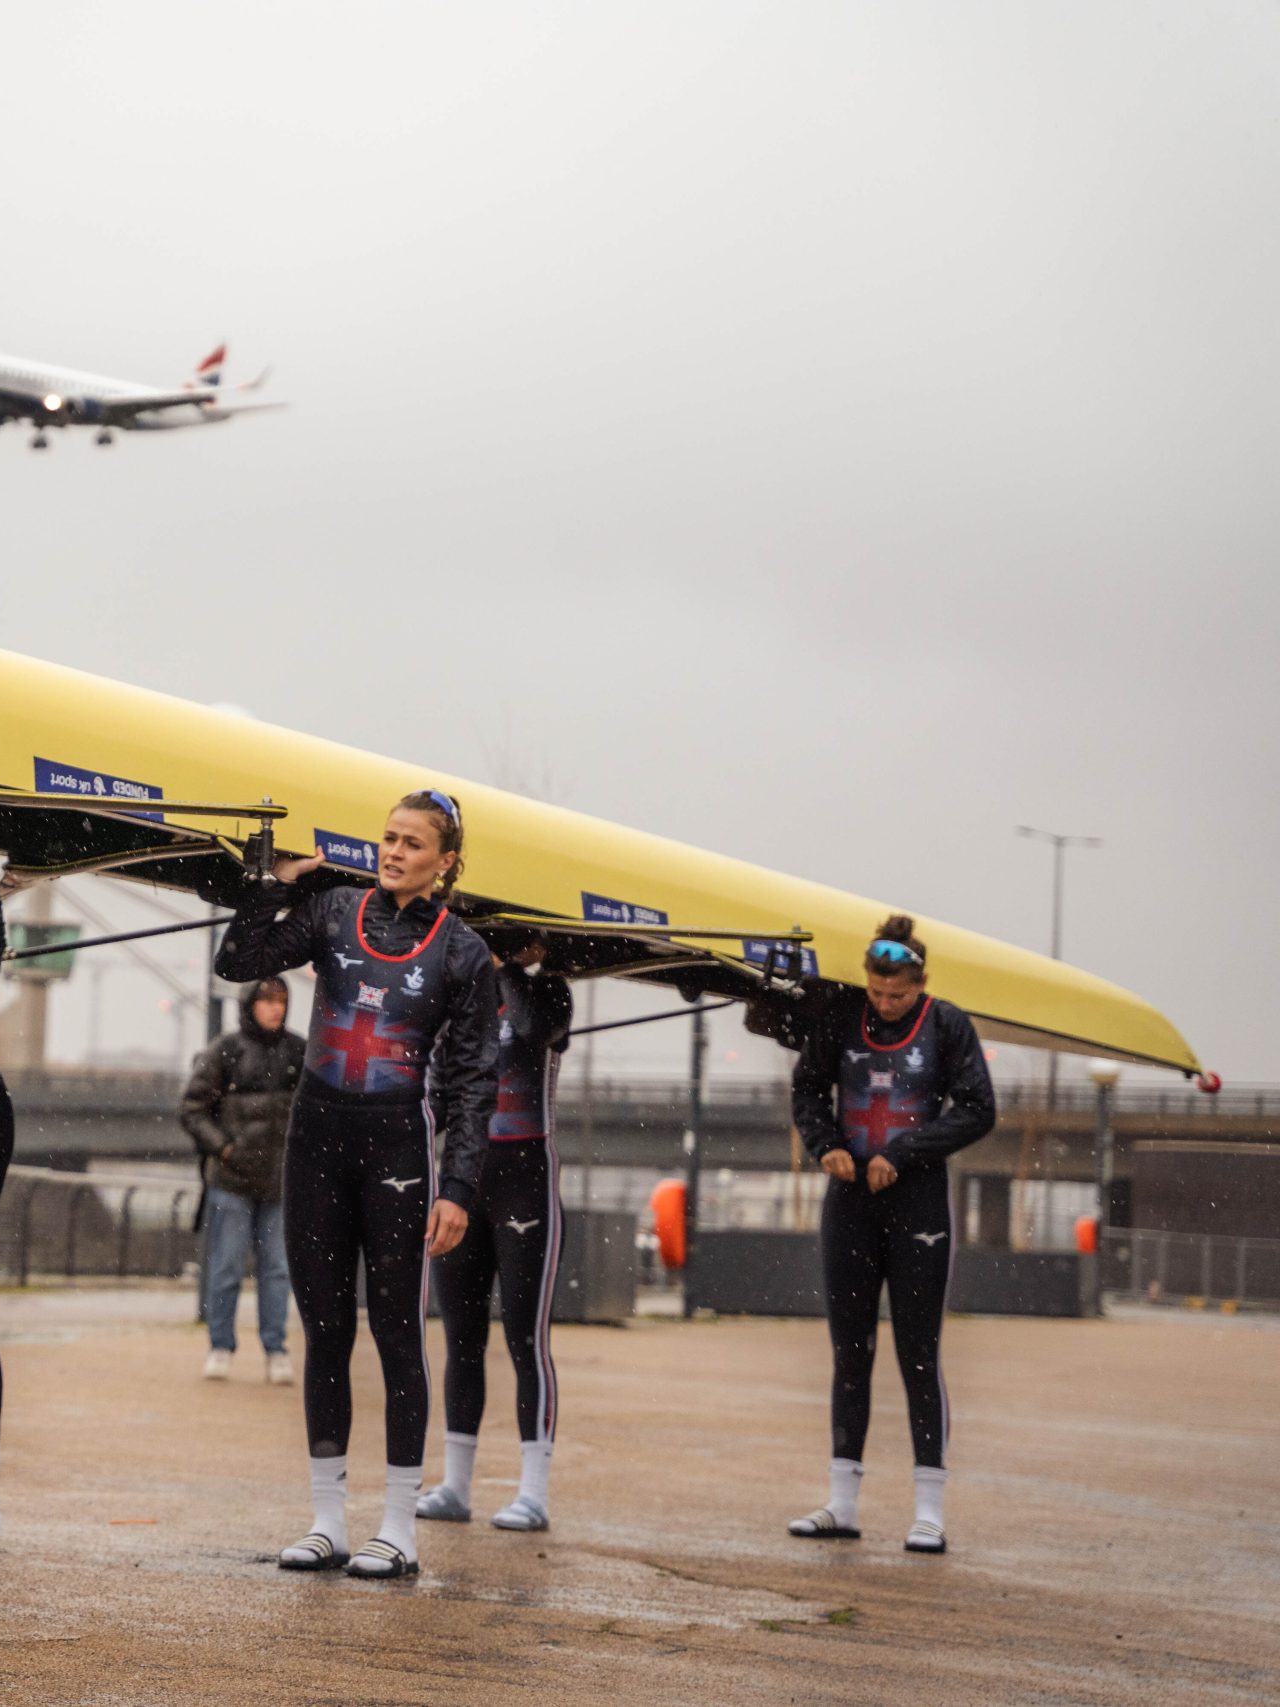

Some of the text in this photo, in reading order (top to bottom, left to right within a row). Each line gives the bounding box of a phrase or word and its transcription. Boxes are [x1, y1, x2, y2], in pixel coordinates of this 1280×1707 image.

[50, 772, 91, 793] uk sport
[112, 780, 149, 799] FUNDED
[327, 842, 351, 858] sport
